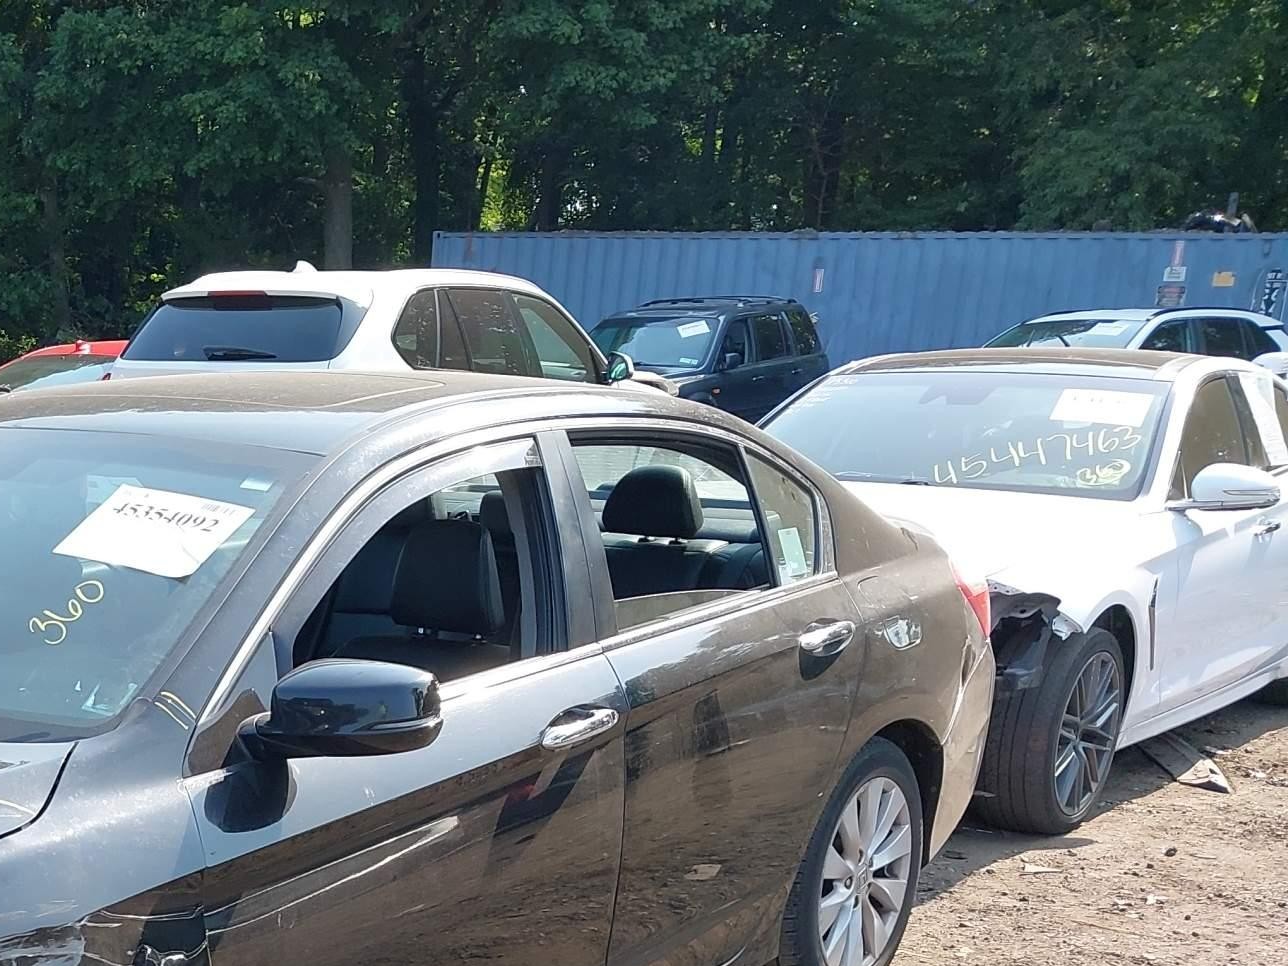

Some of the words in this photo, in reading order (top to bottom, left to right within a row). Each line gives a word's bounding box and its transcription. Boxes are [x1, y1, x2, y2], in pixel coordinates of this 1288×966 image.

[933, 425, 1142, 484] 45447463
[112, 501, 220, 534] 45354092
[29, 579, 105, 646] 360
